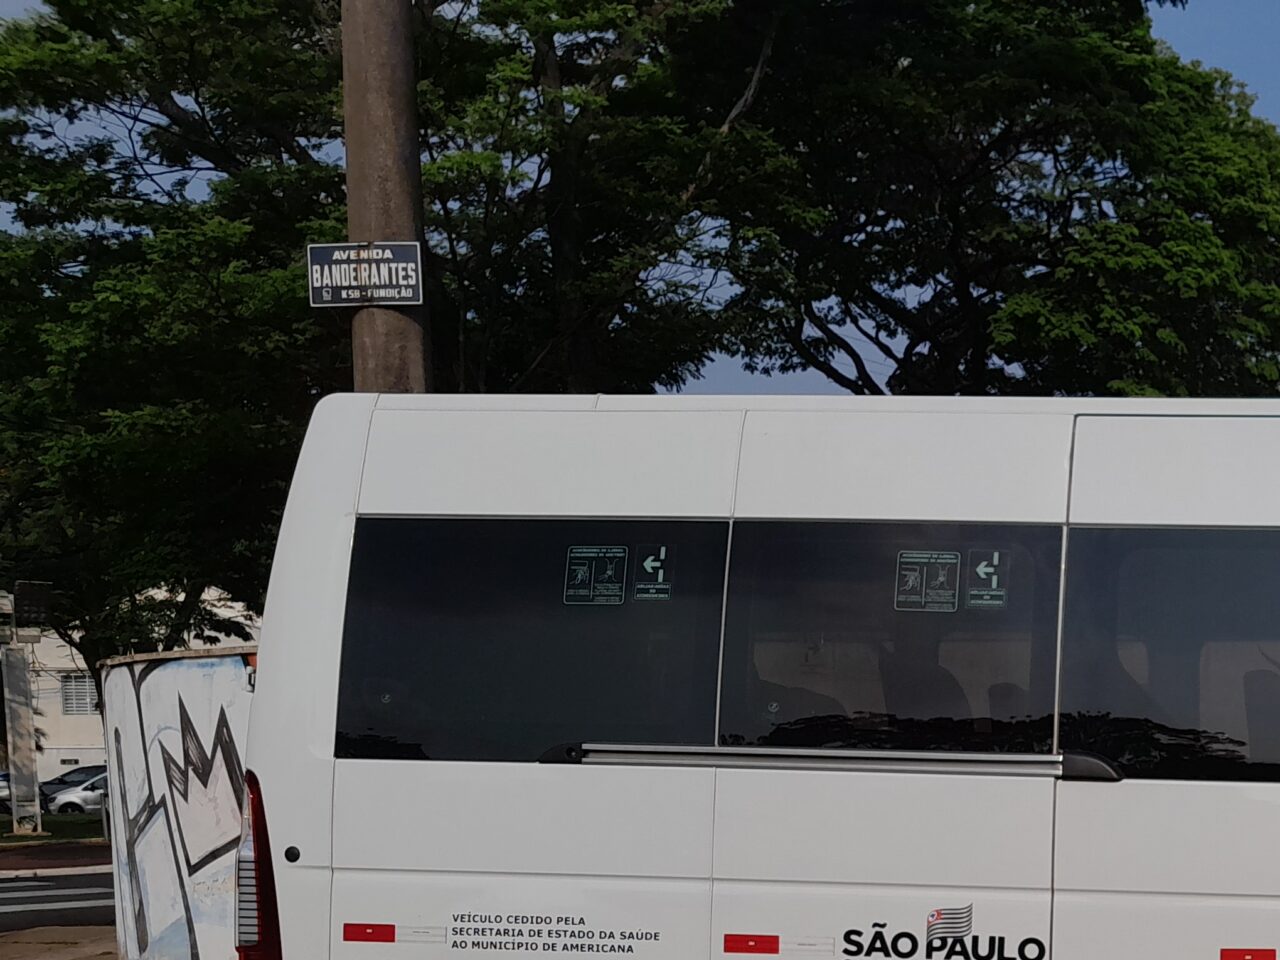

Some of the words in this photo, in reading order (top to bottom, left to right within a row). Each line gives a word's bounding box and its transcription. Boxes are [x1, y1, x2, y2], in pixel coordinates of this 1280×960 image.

[332, 249, 393, 260] AVENIDA
[312, 262, 416, 287] BANDEIRANTES
[367, 286, 413, 299] FUNDIÇÃO
[452, 911, 503, 924] VEÍCULO
[506, 915, 553, 925] CEDIDO
[556, 916, 586, 926] PELA
[451, 927, 524, 938] SECRETARIA
[528, 929, 544, 938] DE
[547, 930, 595, 940] ESTADO
[599, 931, 616, 940] DA
[619, 928, 661, 941] SAÚDE
[842, 922, 919, 959] SÃO
[451, 940, 468, 949] AO
[471, 938, 538, 951] MUNICÍPIO
[542, 942, 558, 952] DE
[561, 943, 635, 954] AMERICANA
